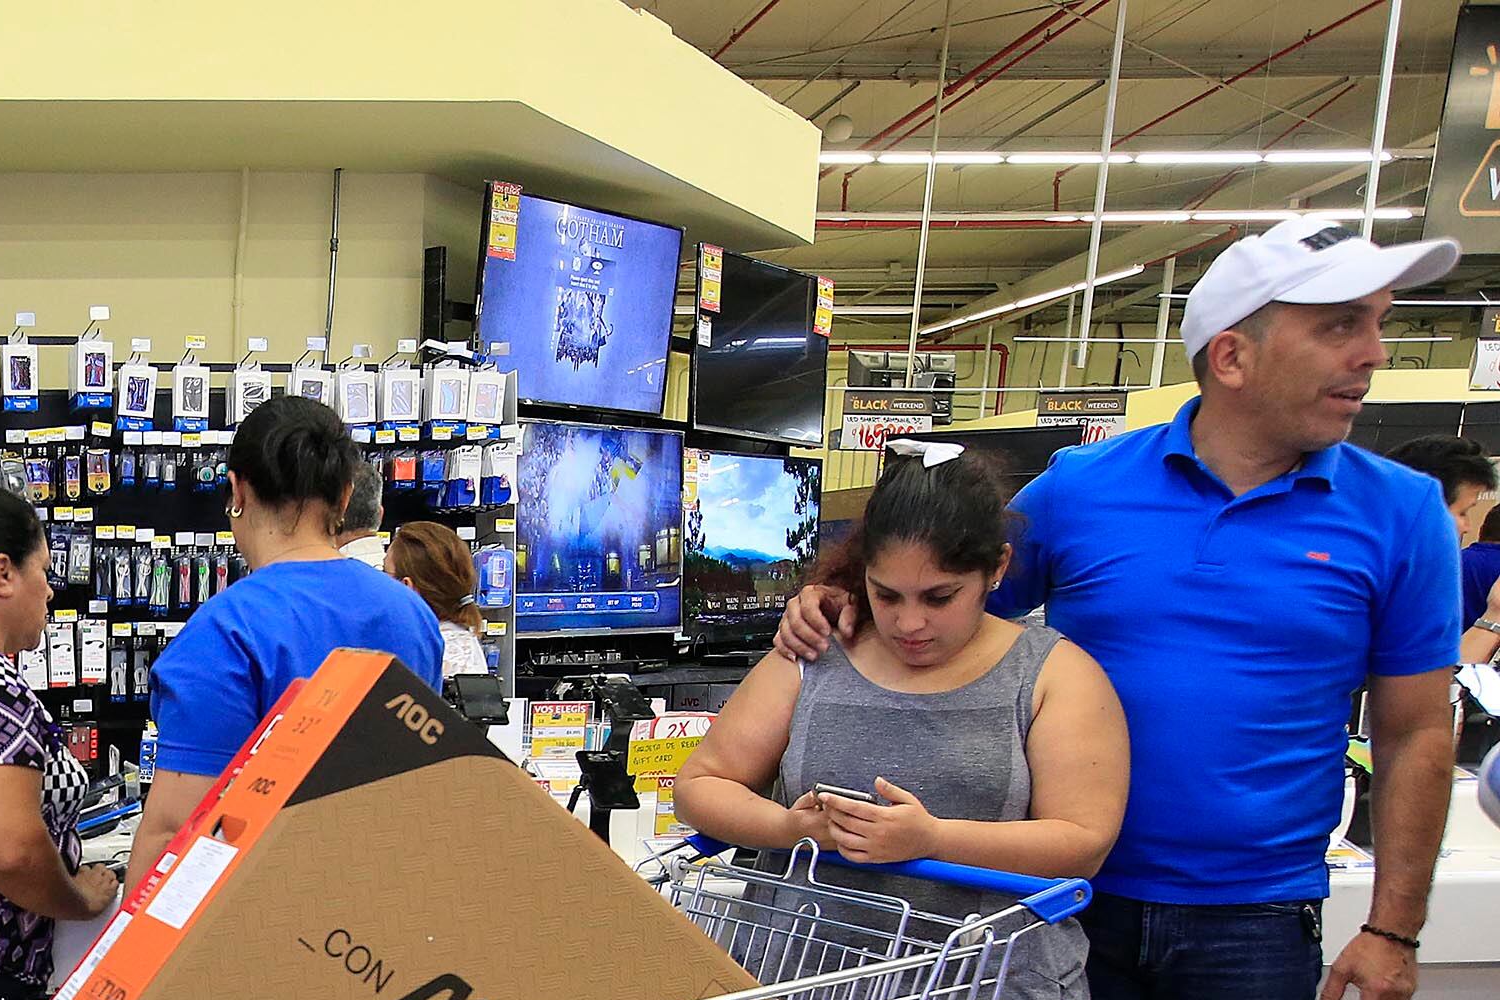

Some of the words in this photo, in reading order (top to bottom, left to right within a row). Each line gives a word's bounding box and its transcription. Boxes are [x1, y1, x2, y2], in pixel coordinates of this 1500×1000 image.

[556, 216, 625, 250] GOTHAM
[852, 399, 888, 410] BLACK
[1047, 400, 1082, 411] BLACK
[681, 698, 699, 707] JVC
[533, 704, 554, 713] VOS
[555, 703, 587, 714] ELEGÍS
[384, 692, 445, 746] AOC
[667, 720, 690, 738] 2X
[666, 742, 675, 750] DE
[632, 757, 650, 765] GIFT
[654, 754, 673, 763] CARD
[247, 776, 277, 796] AOC
[659, 779, 674, 787] VO
